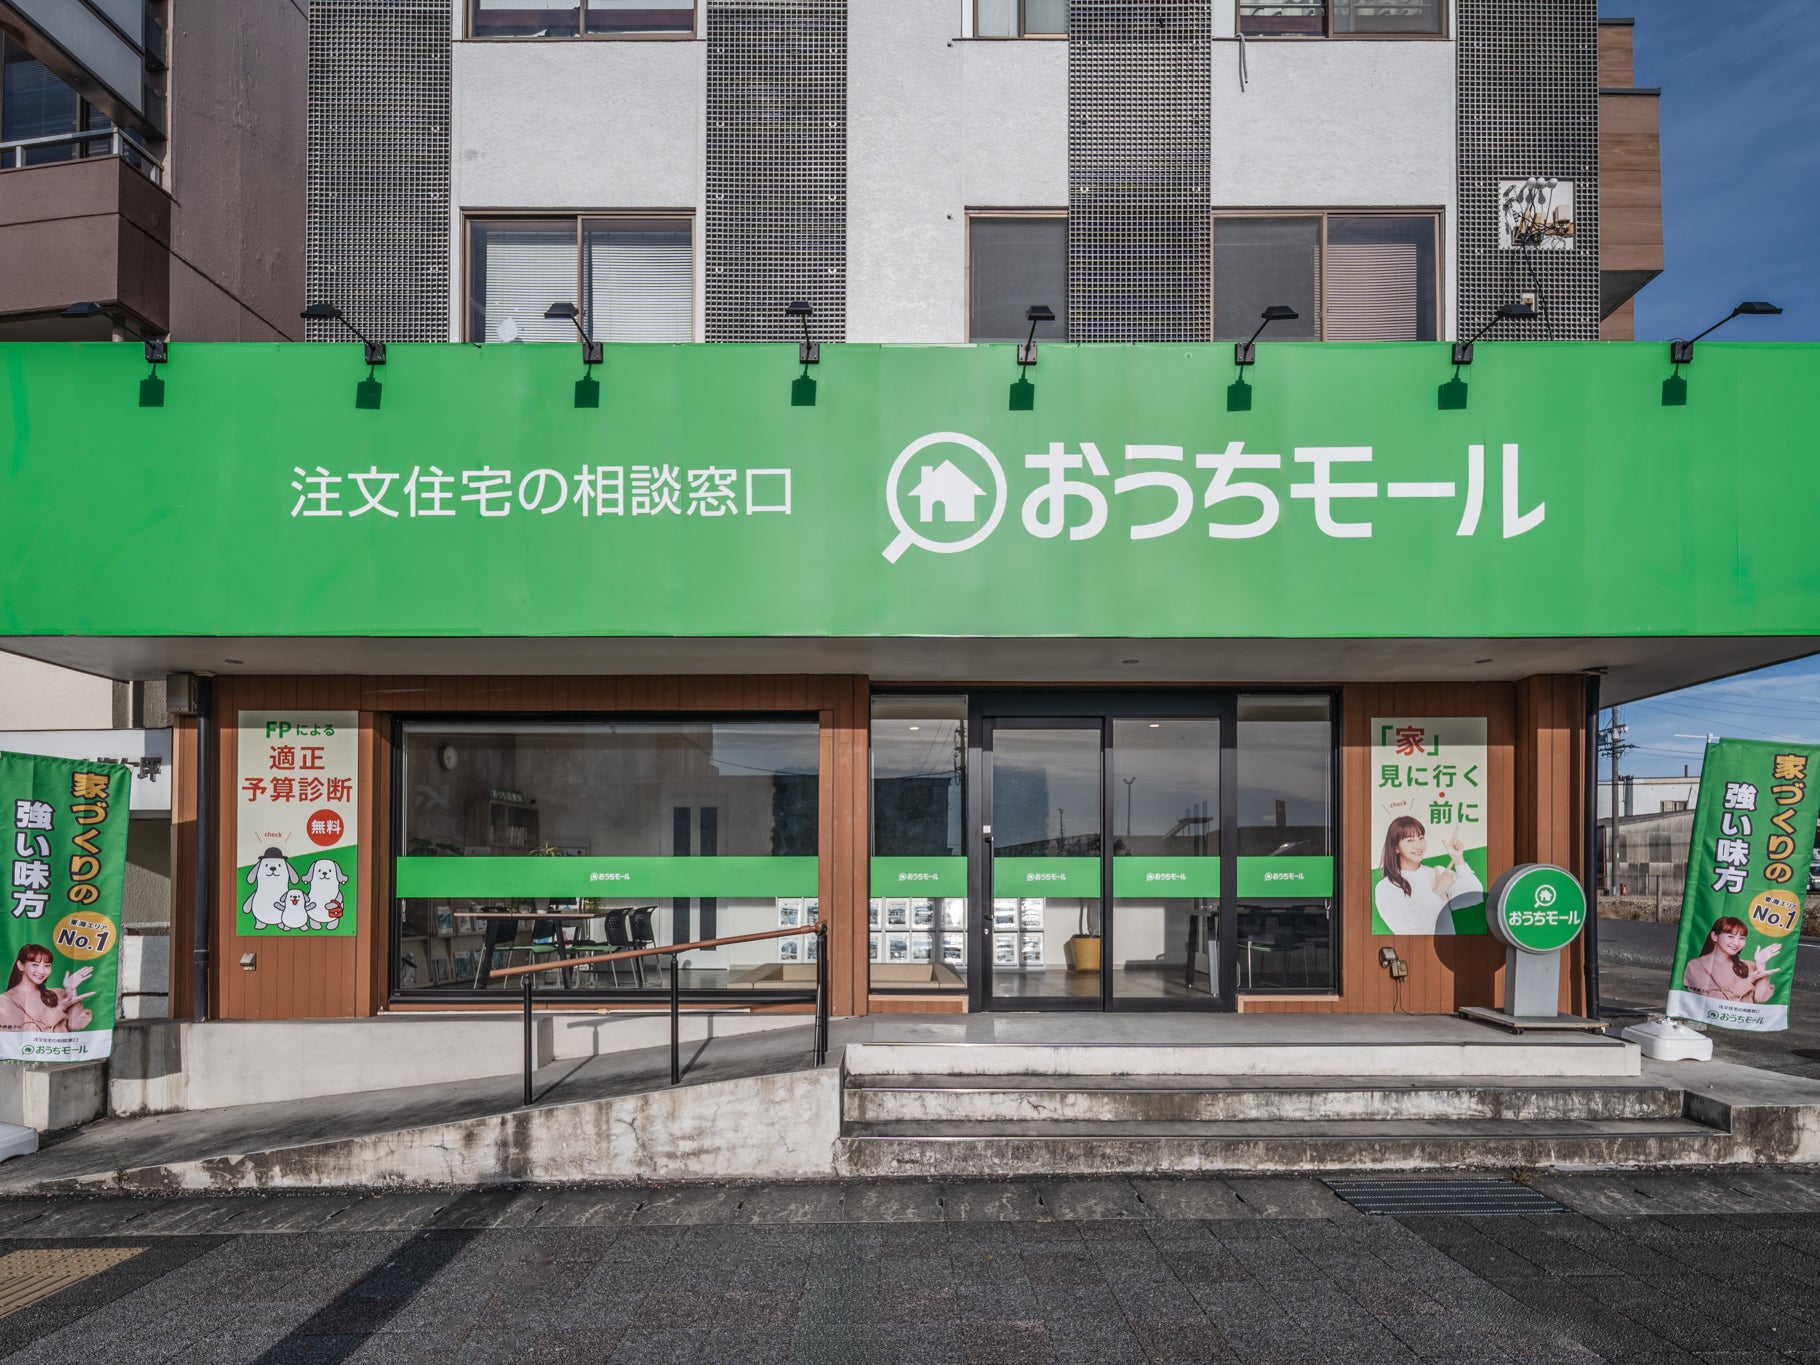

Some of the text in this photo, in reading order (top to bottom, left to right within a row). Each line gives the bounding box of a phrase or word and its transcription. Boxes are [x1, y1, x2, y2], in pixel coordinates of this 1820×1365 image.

[290, 463, 792, 518] 注文住宅の相談窓口
[1021, 441, 1546, 540] おうちモール
[265, 720, 335, 738] FPによる
[1381, 725, 1439, 756] 「家」
[269, 745, 325, 770] 適正
[1379, 764, 1479, 788] 見に行く
[241, 776, 353, 803] 予算診断
[1389, 800, 1408, 809] check
[1429, 801, 1480, 824] 前に
[311, 819, 342, 835] 無料
[1763, 753, 1808, 884] 家づくりの
[67, 771, 110, 906] 家づくりの
[1711, 781, 1759, 894] 強い味方
[10, 798, 55, 919] 強い味方
[1508, 910, 1581, 926] おうちモール
[1751, 905, 1798, 931] No.1
[57, 927, 110, 953] No.1
[1719, 1013, 1765, 1025] おうちモール
[35, 1045, 89, 1055] おうちモール
